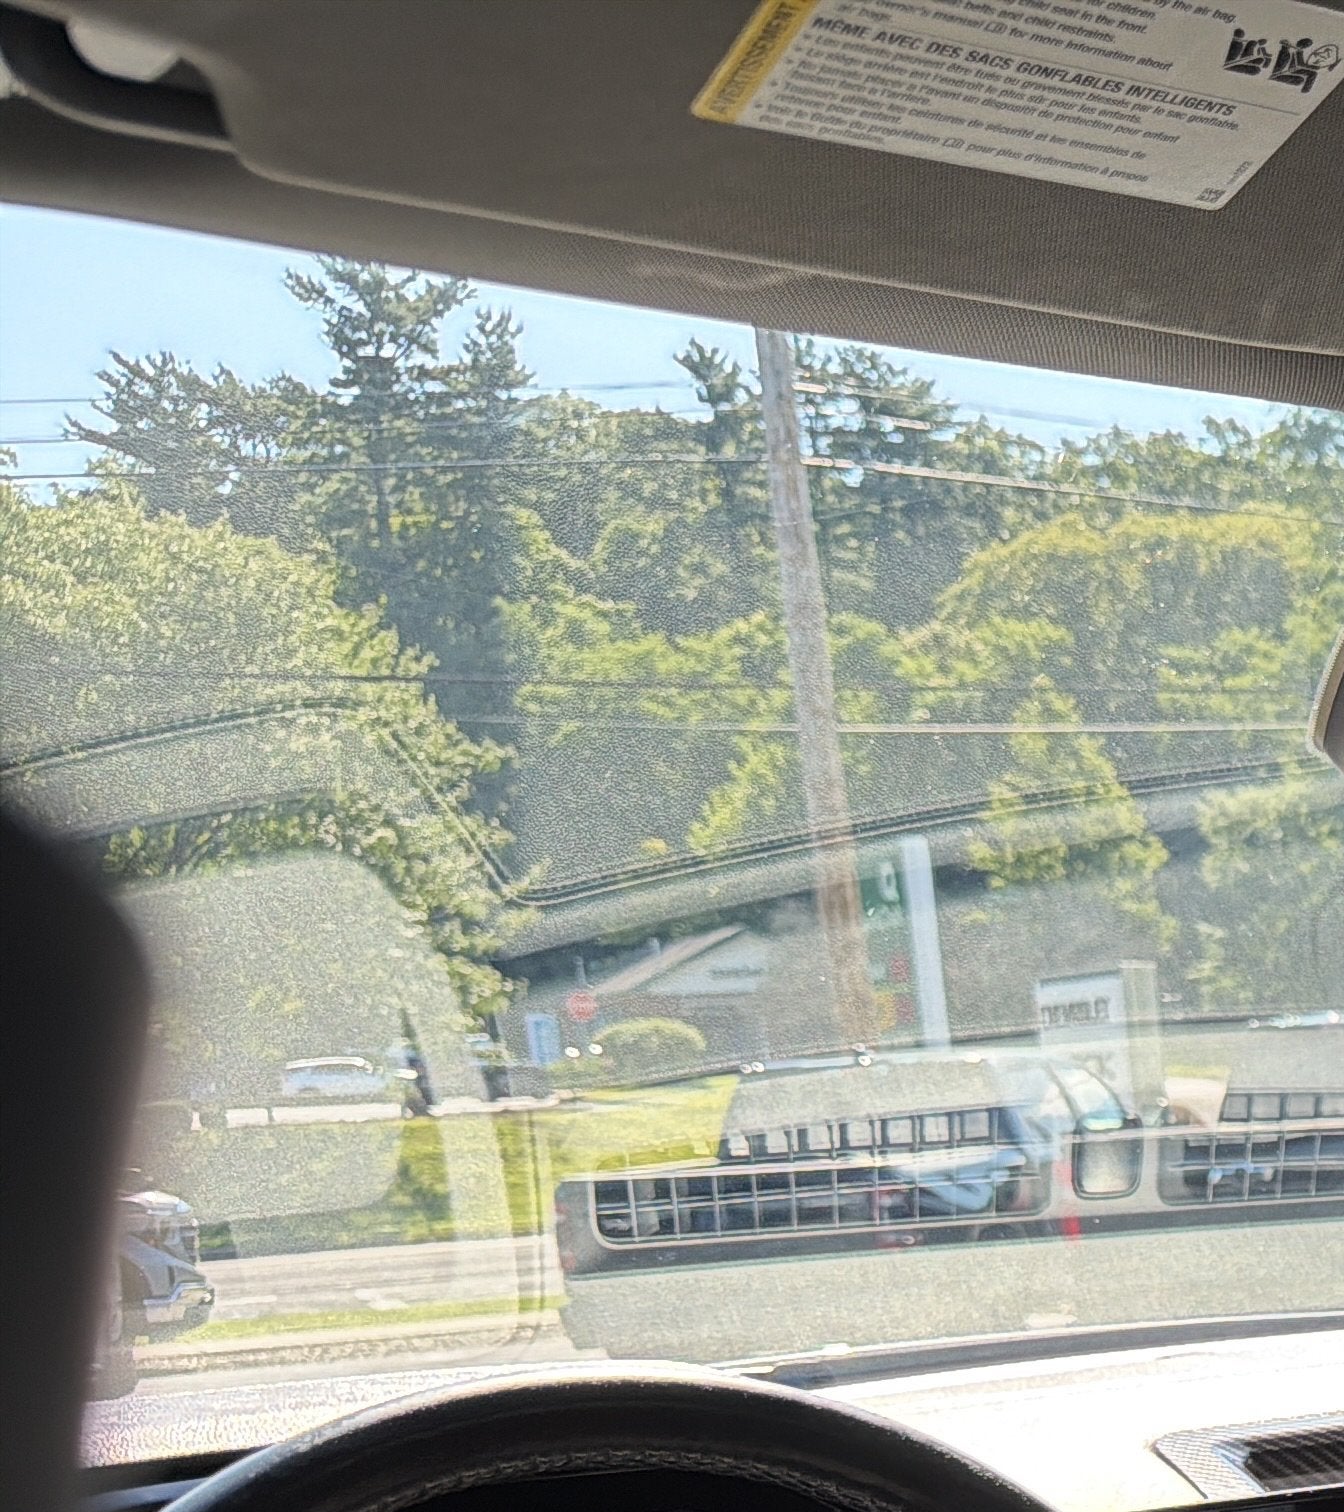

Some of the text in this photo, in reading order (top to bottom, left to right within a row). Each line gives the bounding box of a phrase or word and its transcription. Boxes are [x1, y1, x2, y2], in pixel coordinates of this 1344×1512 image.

[1052, 5, 1078, 20] seat
[1095, 13, 1115, 28] the
[1106, 2, 1157, 20] children.
[810, 13, 1237, 117] MÊME AVEC DES SACS GONFLABLES INTELLIGENTS
[1066, 38, 1136, 64] information
[1136, 56, 1173, 72] about
